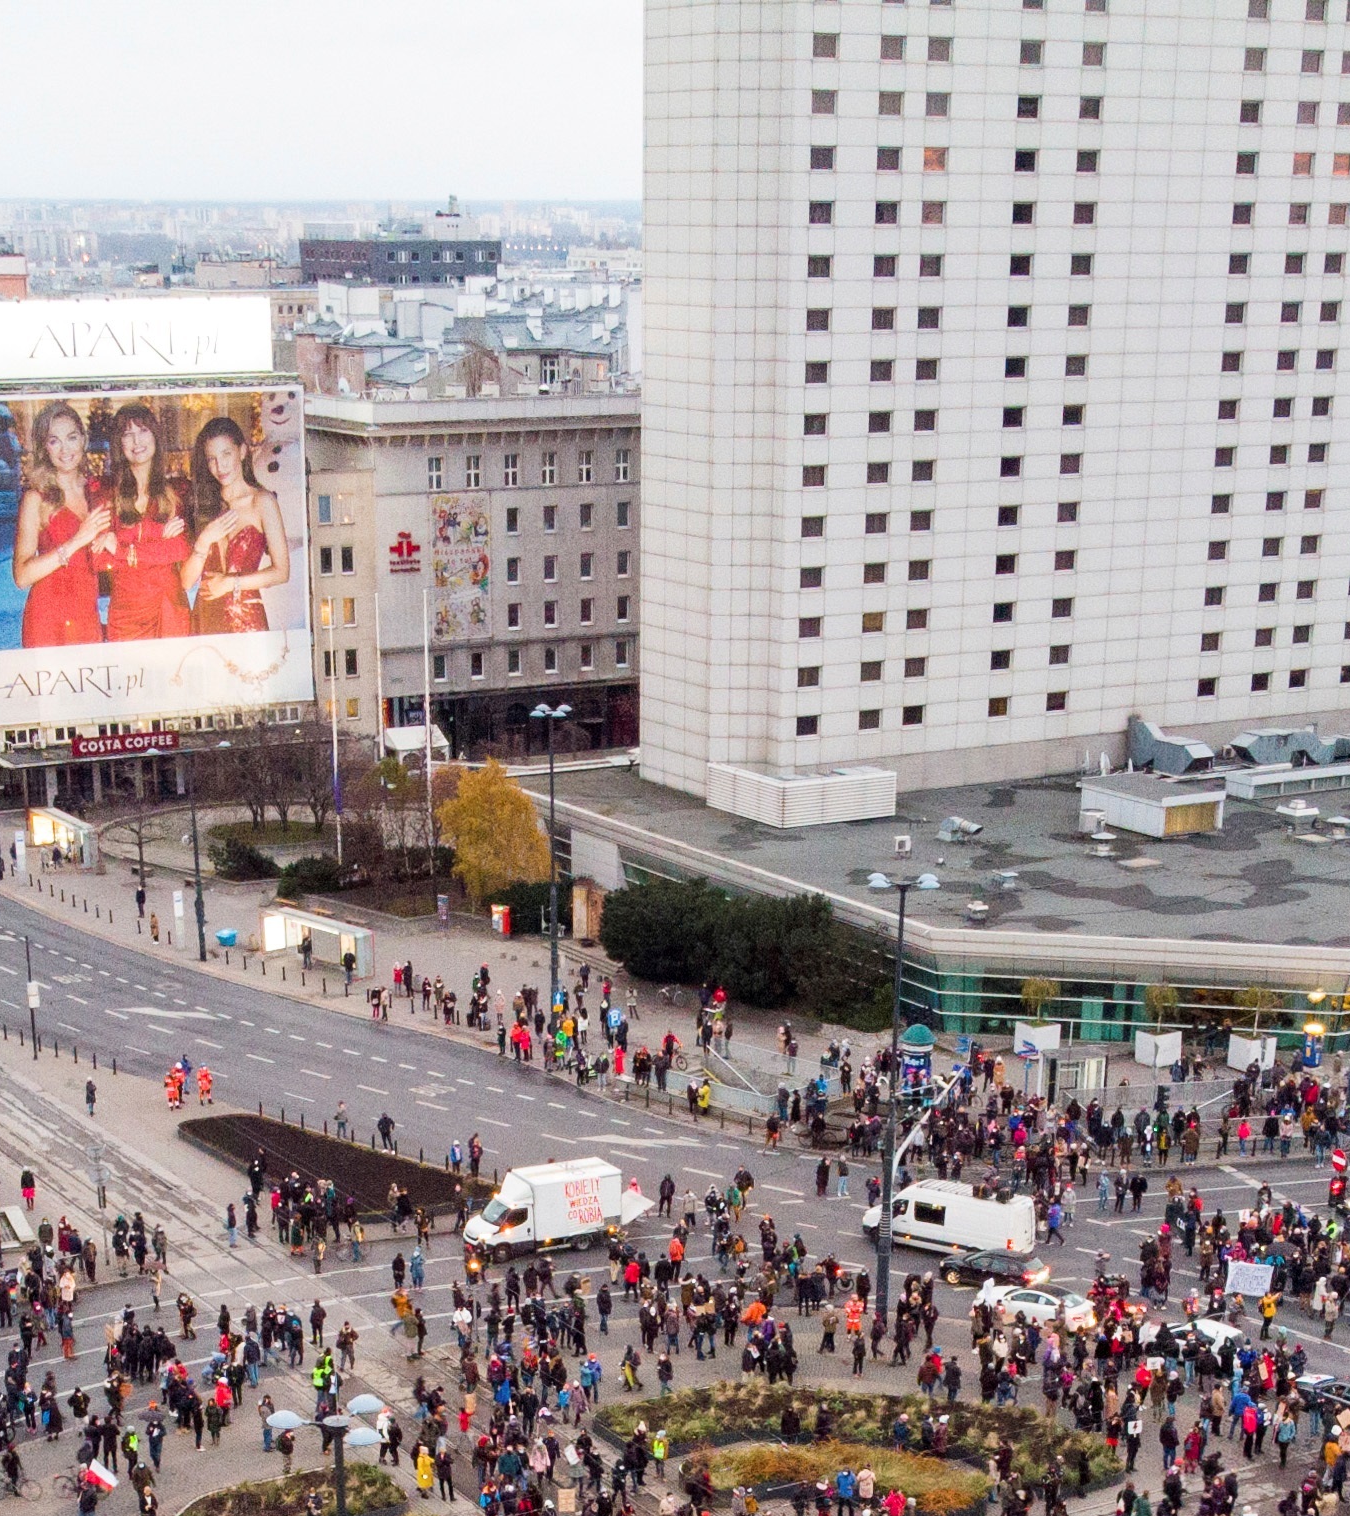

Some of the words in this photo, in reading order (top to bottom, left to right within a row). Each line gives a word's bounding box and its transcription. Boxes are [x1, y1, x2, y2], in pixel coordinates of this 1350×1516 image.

[29, 321, 219, 367] APART.pl
[6, 665, 144, 698] APART.pl
[79, 739, 122, 754] COSTA
[125, 735, 173, 750] COFFEE
[564, 1178, 601, 1198] KOBIETY
[568, 1210, 578, 1221] CO
